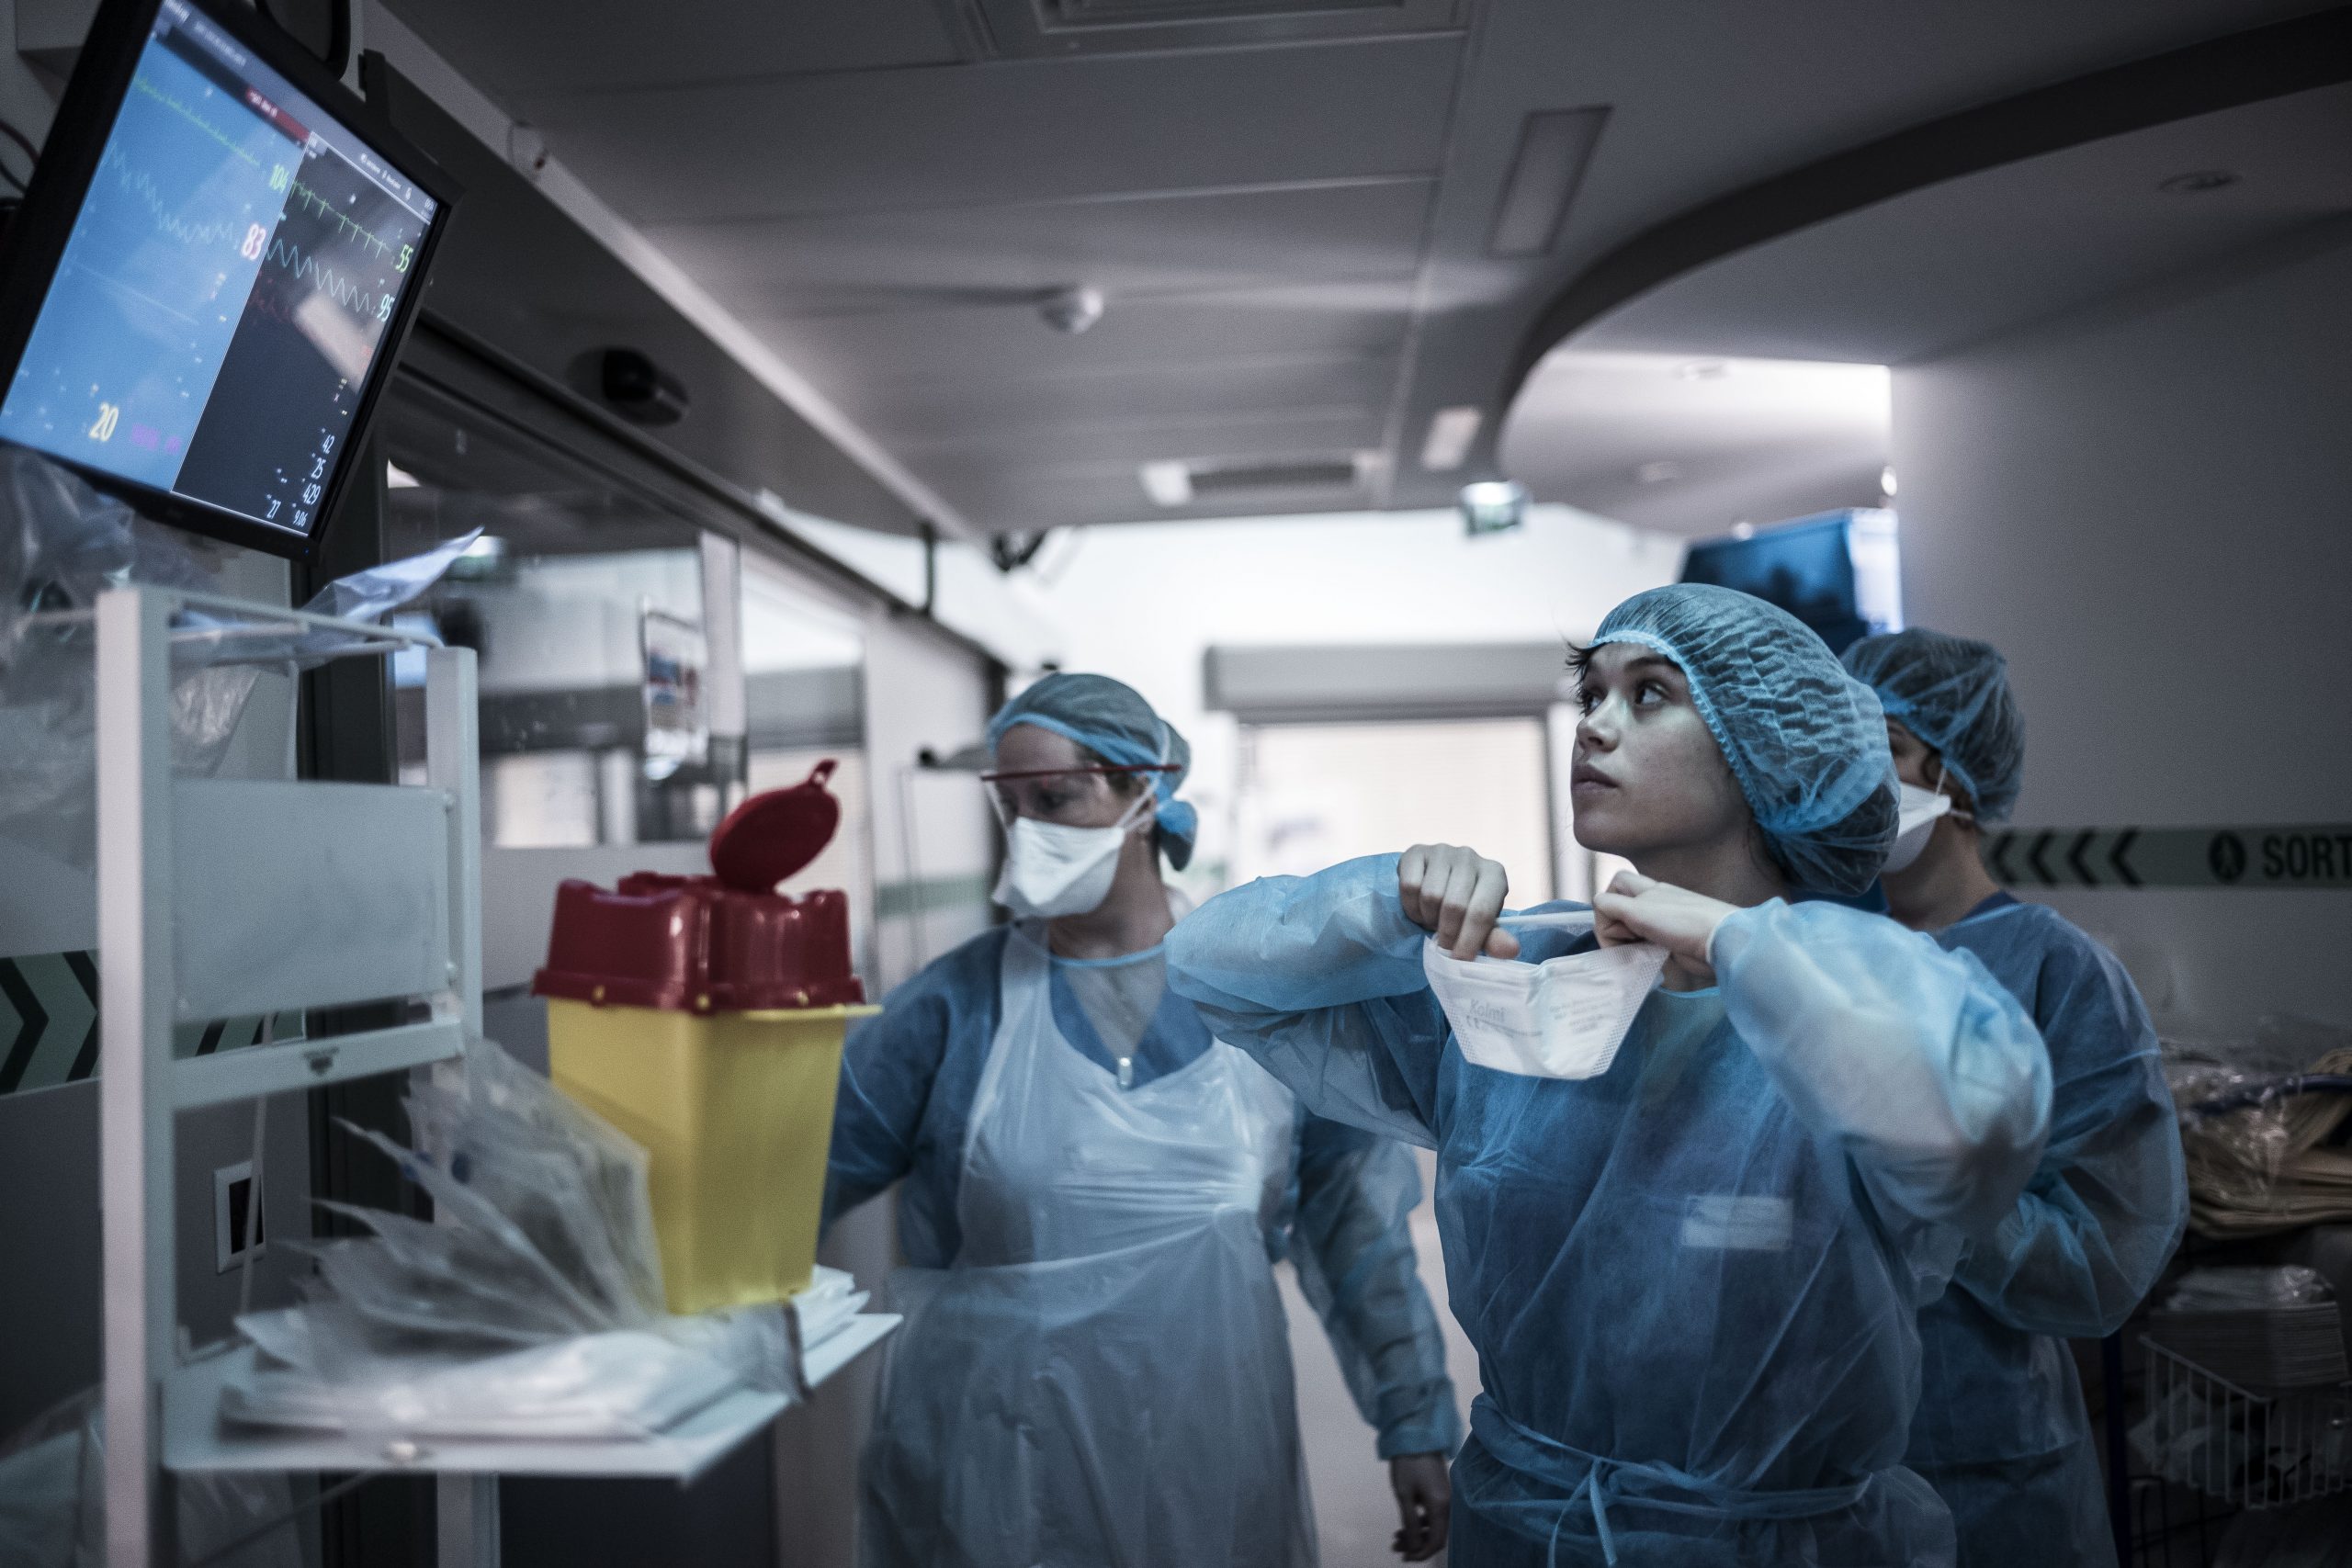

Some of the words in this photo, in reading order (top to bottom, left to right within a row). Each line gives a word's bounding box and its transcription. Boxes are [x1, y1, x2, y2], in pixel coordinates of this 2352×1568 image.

[242, 223, 266, 261] 83
[395, 243, 413, 273] 55
[377, 293, 395, 322] 95
[88, 401, 119, 442] 20
[322, 434, 335, 455] 42
[311, 457, 327, 479] 25
[302, 482, 322, 506] 429
[266, 499, 282, 520] 27
[2262, 833, 2352, 879] SORT
